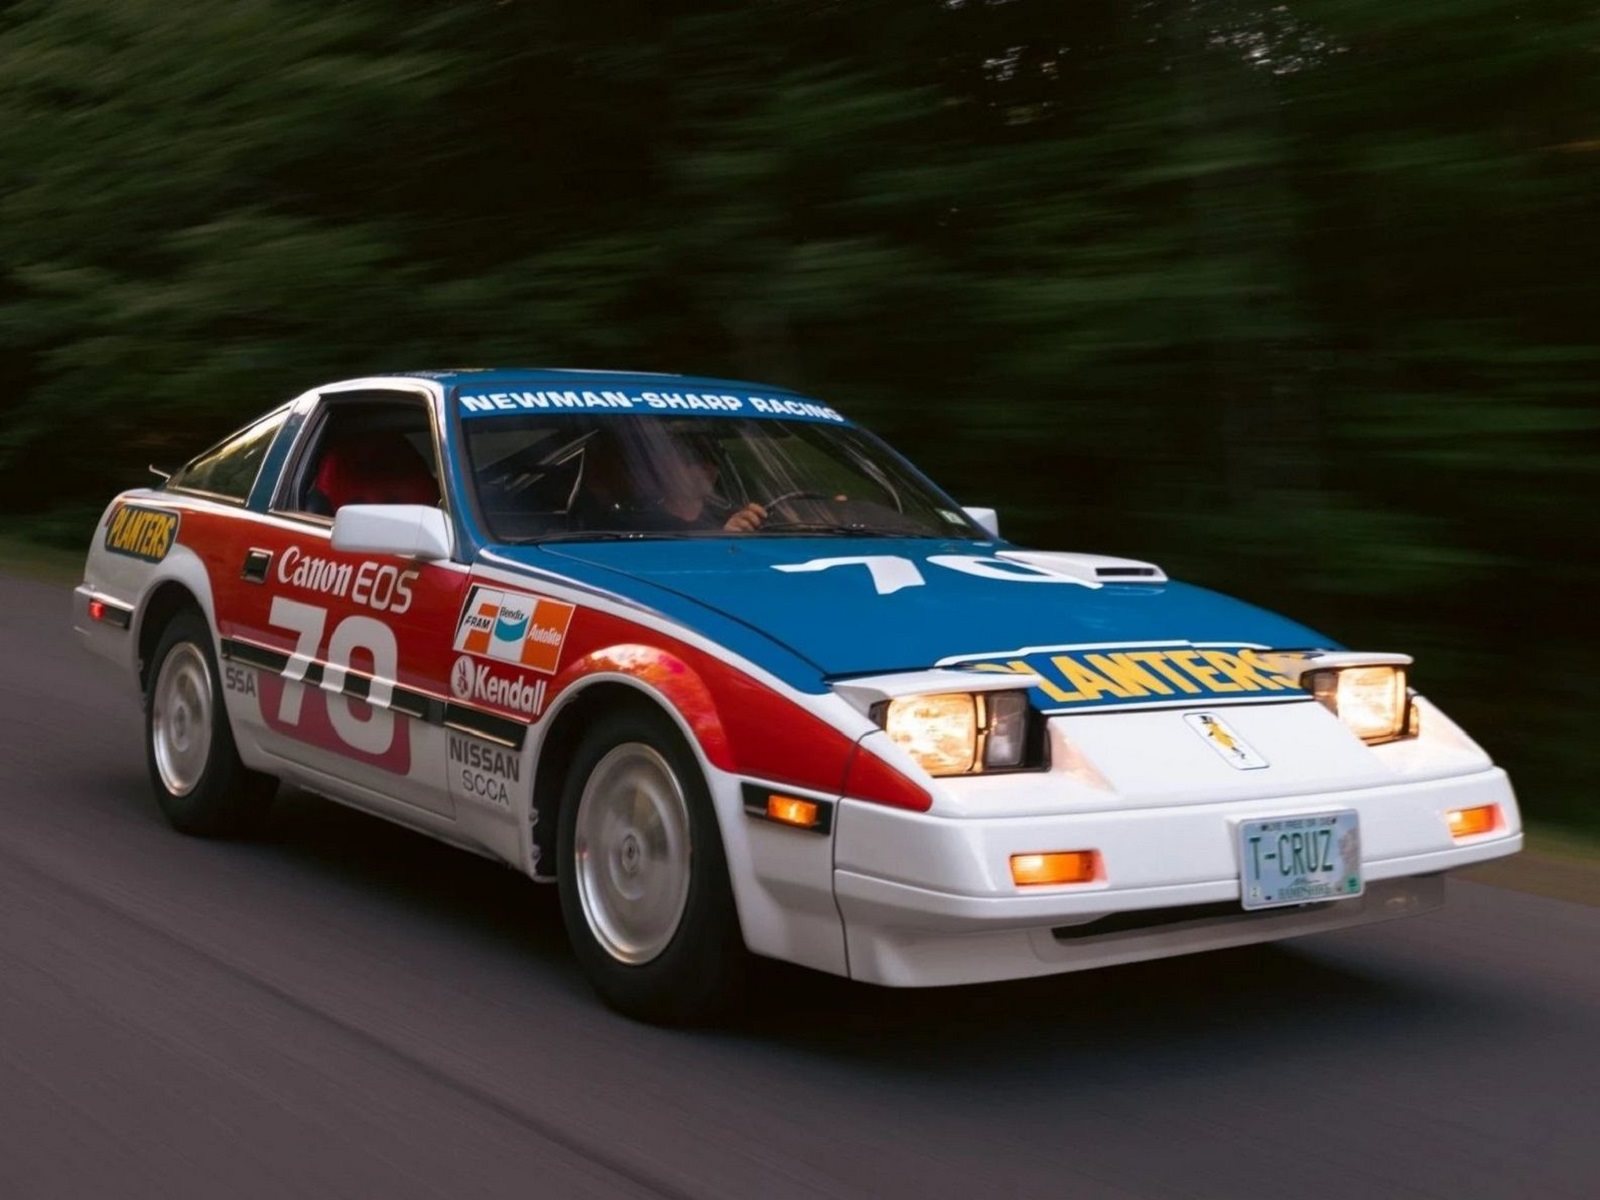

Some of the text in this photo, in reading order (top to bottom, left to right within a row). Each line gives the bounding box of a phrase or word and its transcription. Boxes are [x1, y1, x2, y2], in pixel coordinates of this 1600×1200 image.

[459, 390, 844, 422] NEWMAN-SHARP RACING
[107, 506, 176, 559] PLANTERS
[277, 545, 420, 615] Canon EOS
[769, 554, 1104, 596] 70
[463, 615, 491, 630] FRAM
[500, 606, 525, 621] Bendix
[527, 623, 562, 647] Autolite
[268, 595, 398, 755] 70
[474, 664, 548, 716] Kendall
[974, 648, 1302, 703] LANTERS
[450, 736, 520, 783] NISSAN
[462, 768, 510, 806] SCCA
[1249, 829, 1334, 880] T-CRUZ
